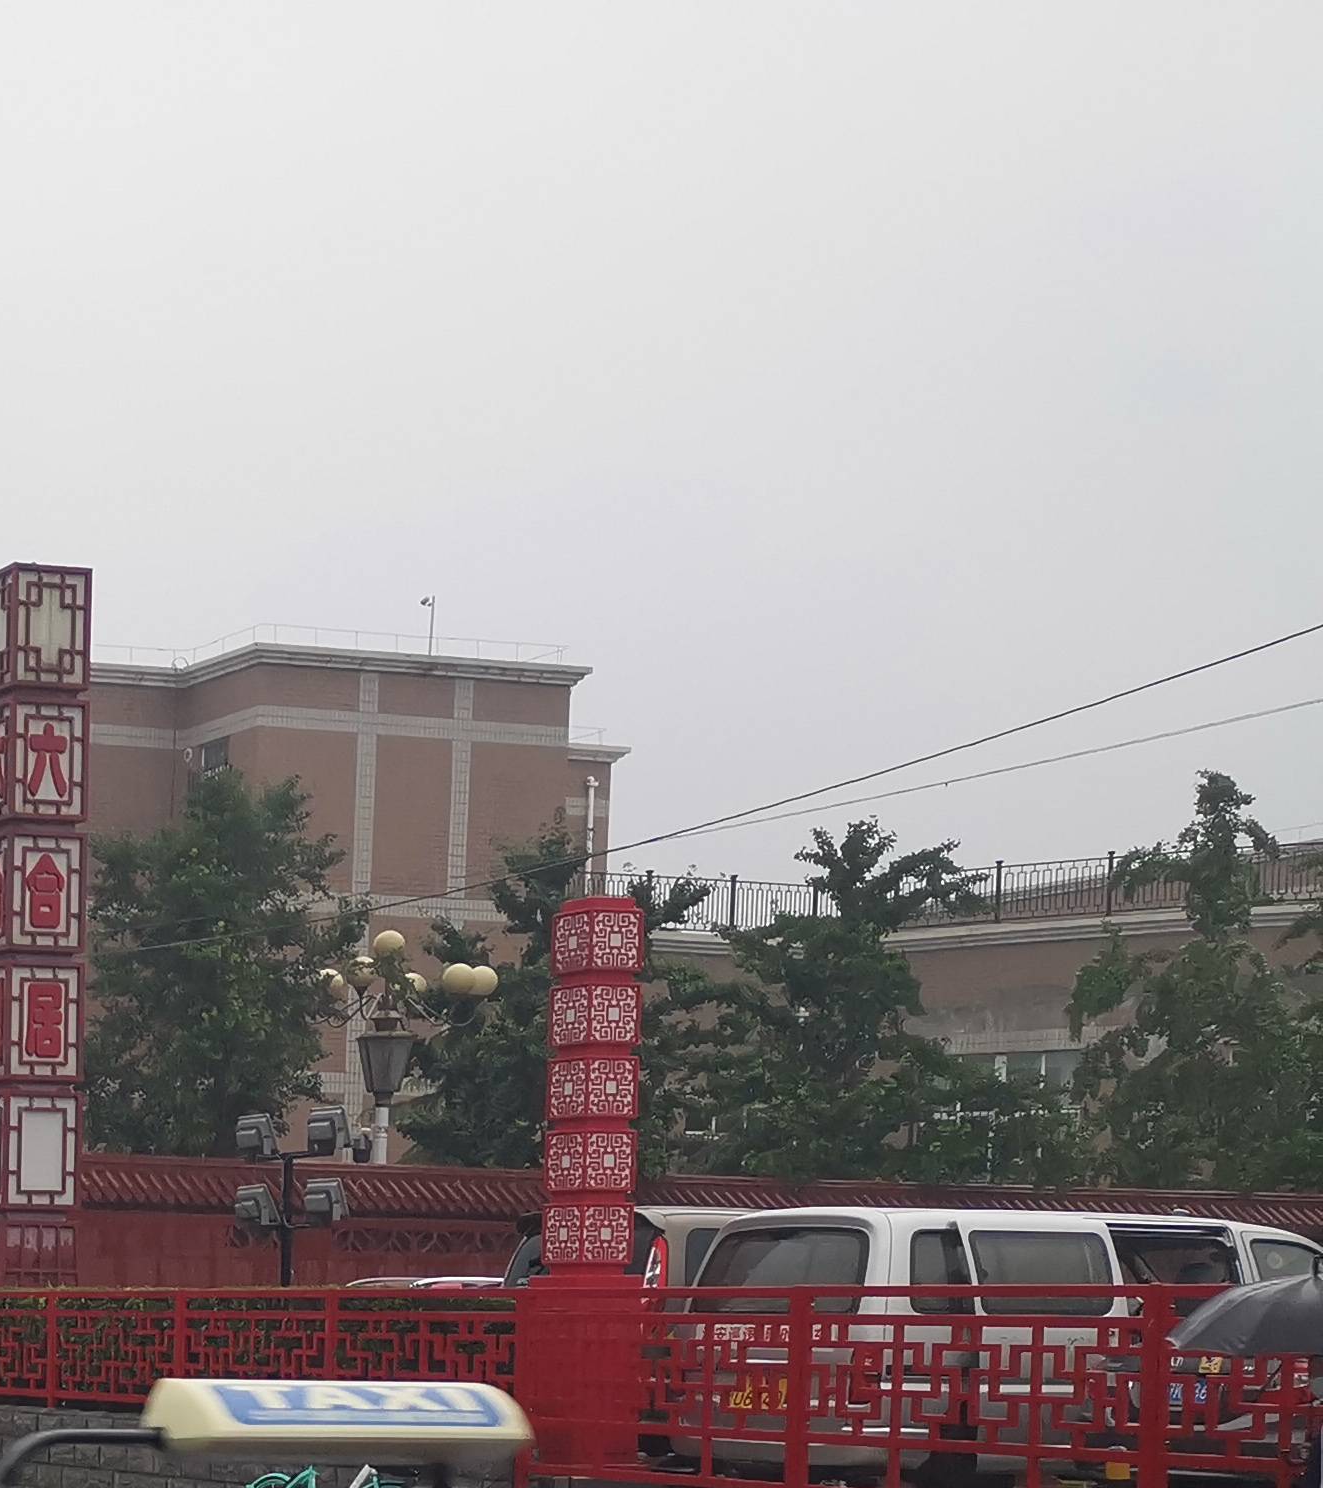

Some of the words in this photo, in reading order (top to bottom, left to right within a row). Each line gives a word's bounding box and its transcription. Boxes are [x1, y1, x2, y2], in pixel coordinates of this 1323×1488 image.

[25, 721, 68, 1059] 六合居
[223, 1385, 484, 1410] TAXI
